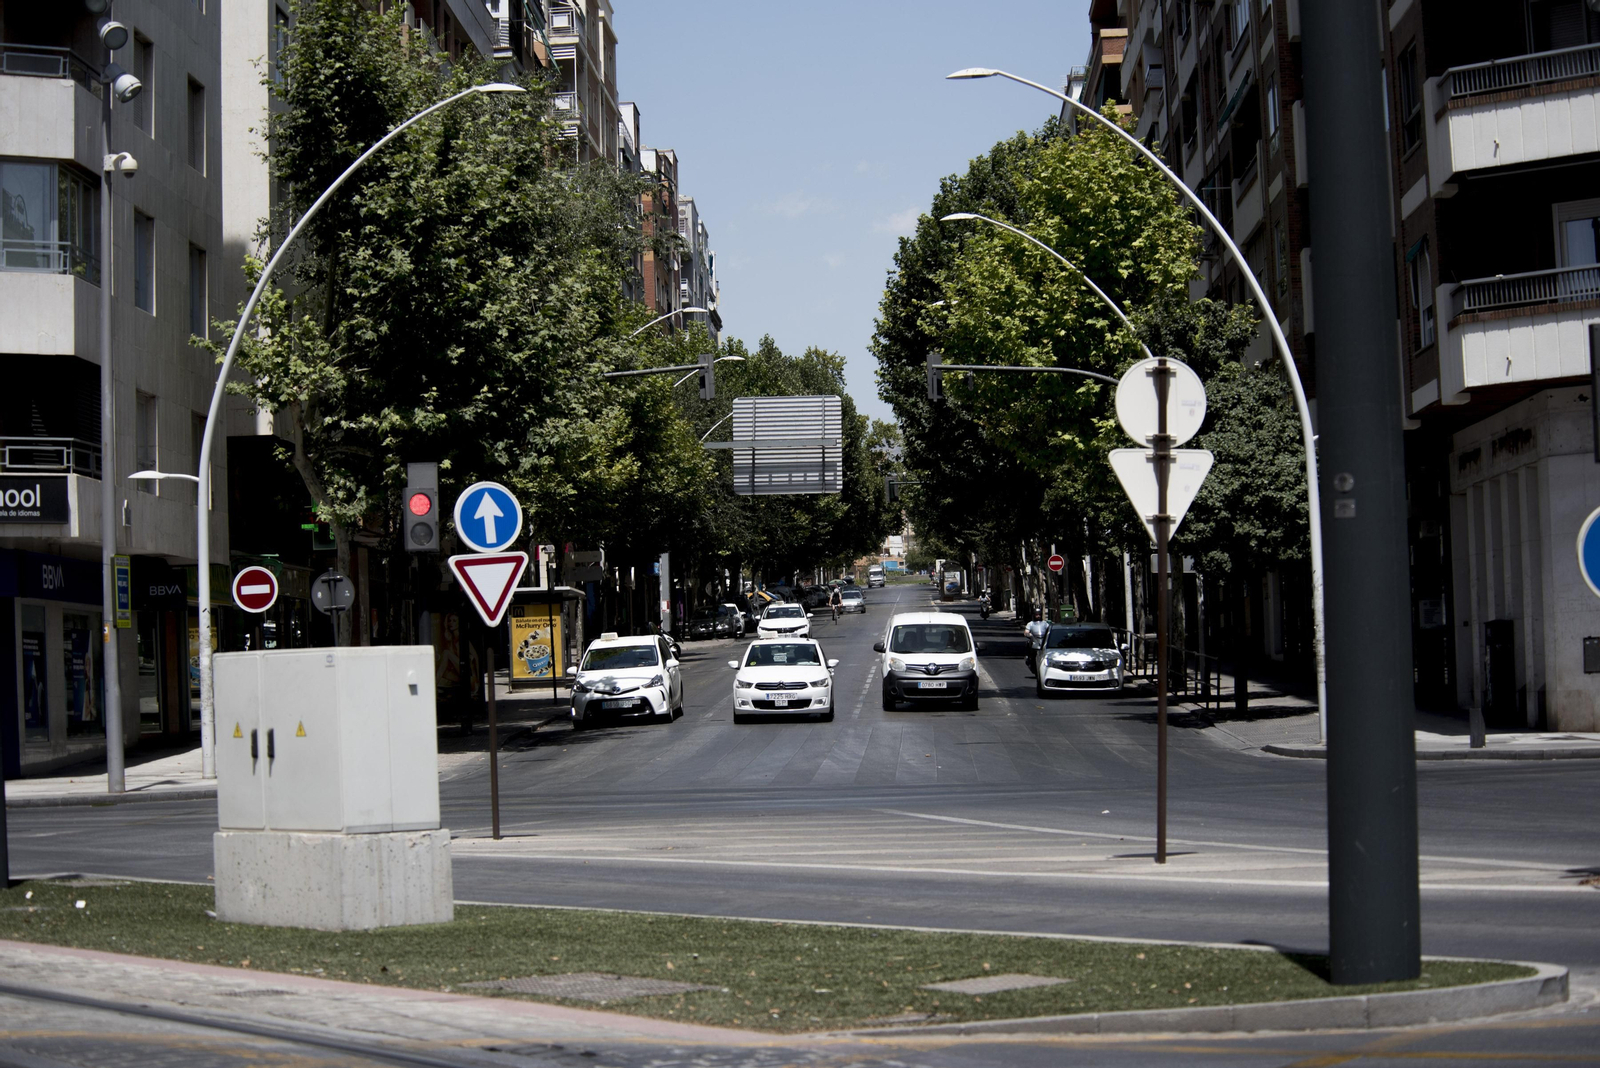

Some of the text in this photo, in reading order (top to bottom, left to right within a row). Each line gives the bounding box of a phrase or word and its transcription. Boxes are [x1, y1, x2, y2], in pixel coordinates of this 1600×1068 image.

[0, 484, 41, 508] ool
[42, 564, 65, 589] BBVA
[149, 585, 182, 596] BBVA
